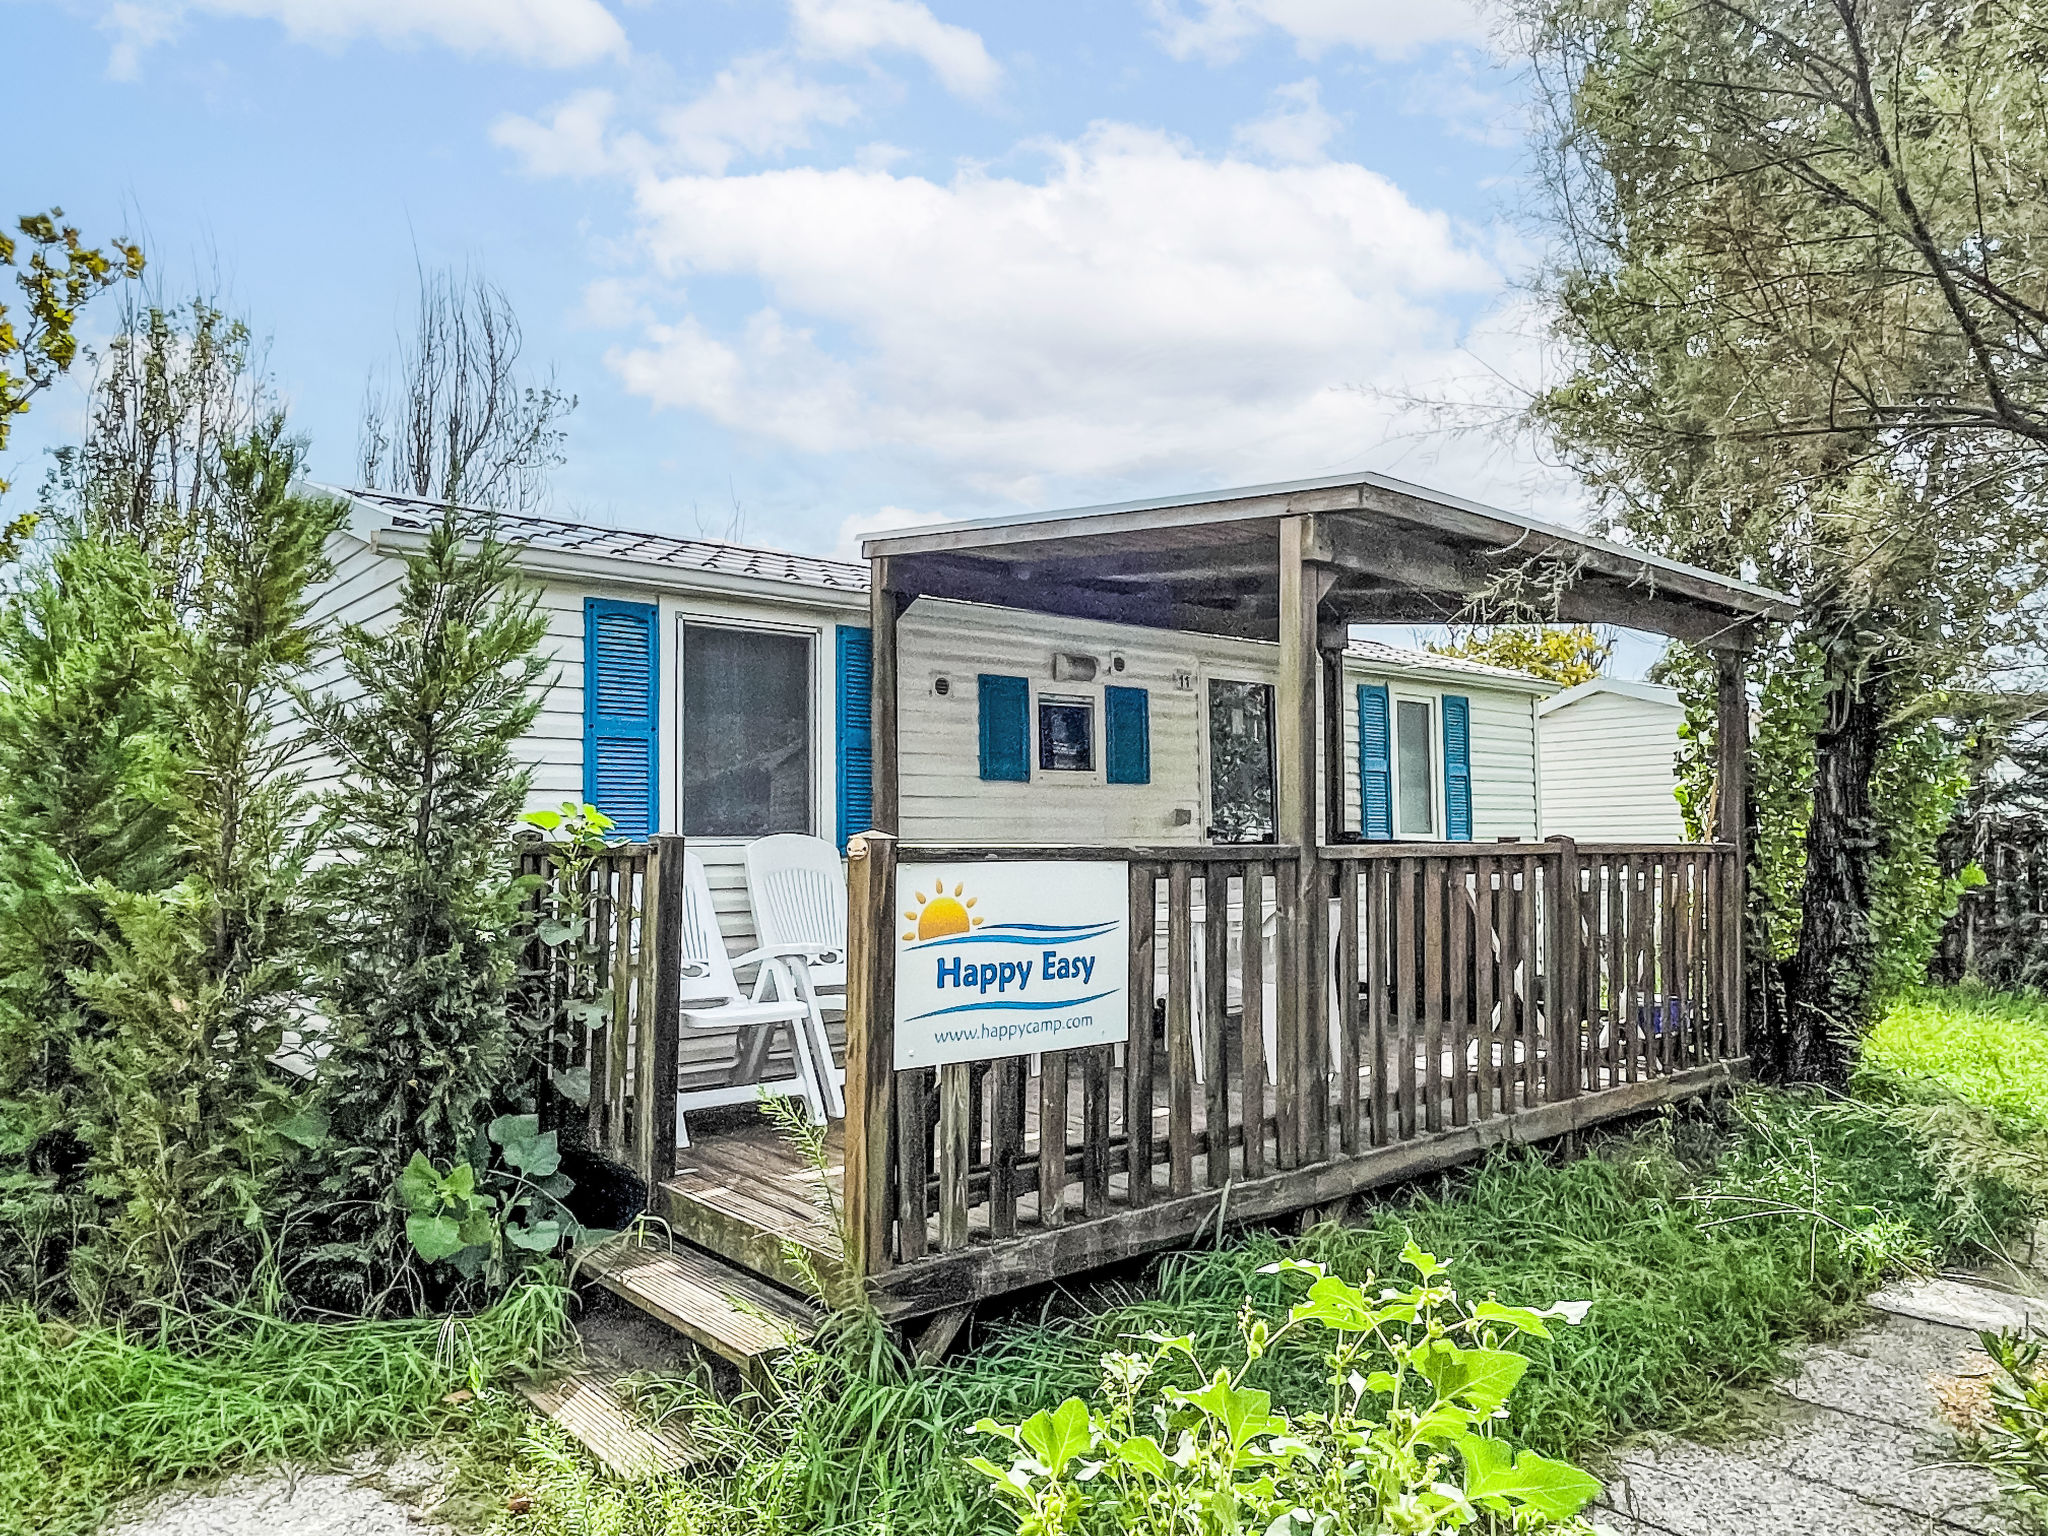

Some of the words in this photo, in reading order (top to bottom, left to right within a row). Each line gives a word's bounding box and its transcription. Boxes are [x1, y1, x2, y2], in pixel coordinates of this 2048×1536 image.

[936, 956, 1033, 994] Happy
[1042, 950, 1096, 985] Easy
[934, 1015, 1094, 1044] www.happycamp.com
